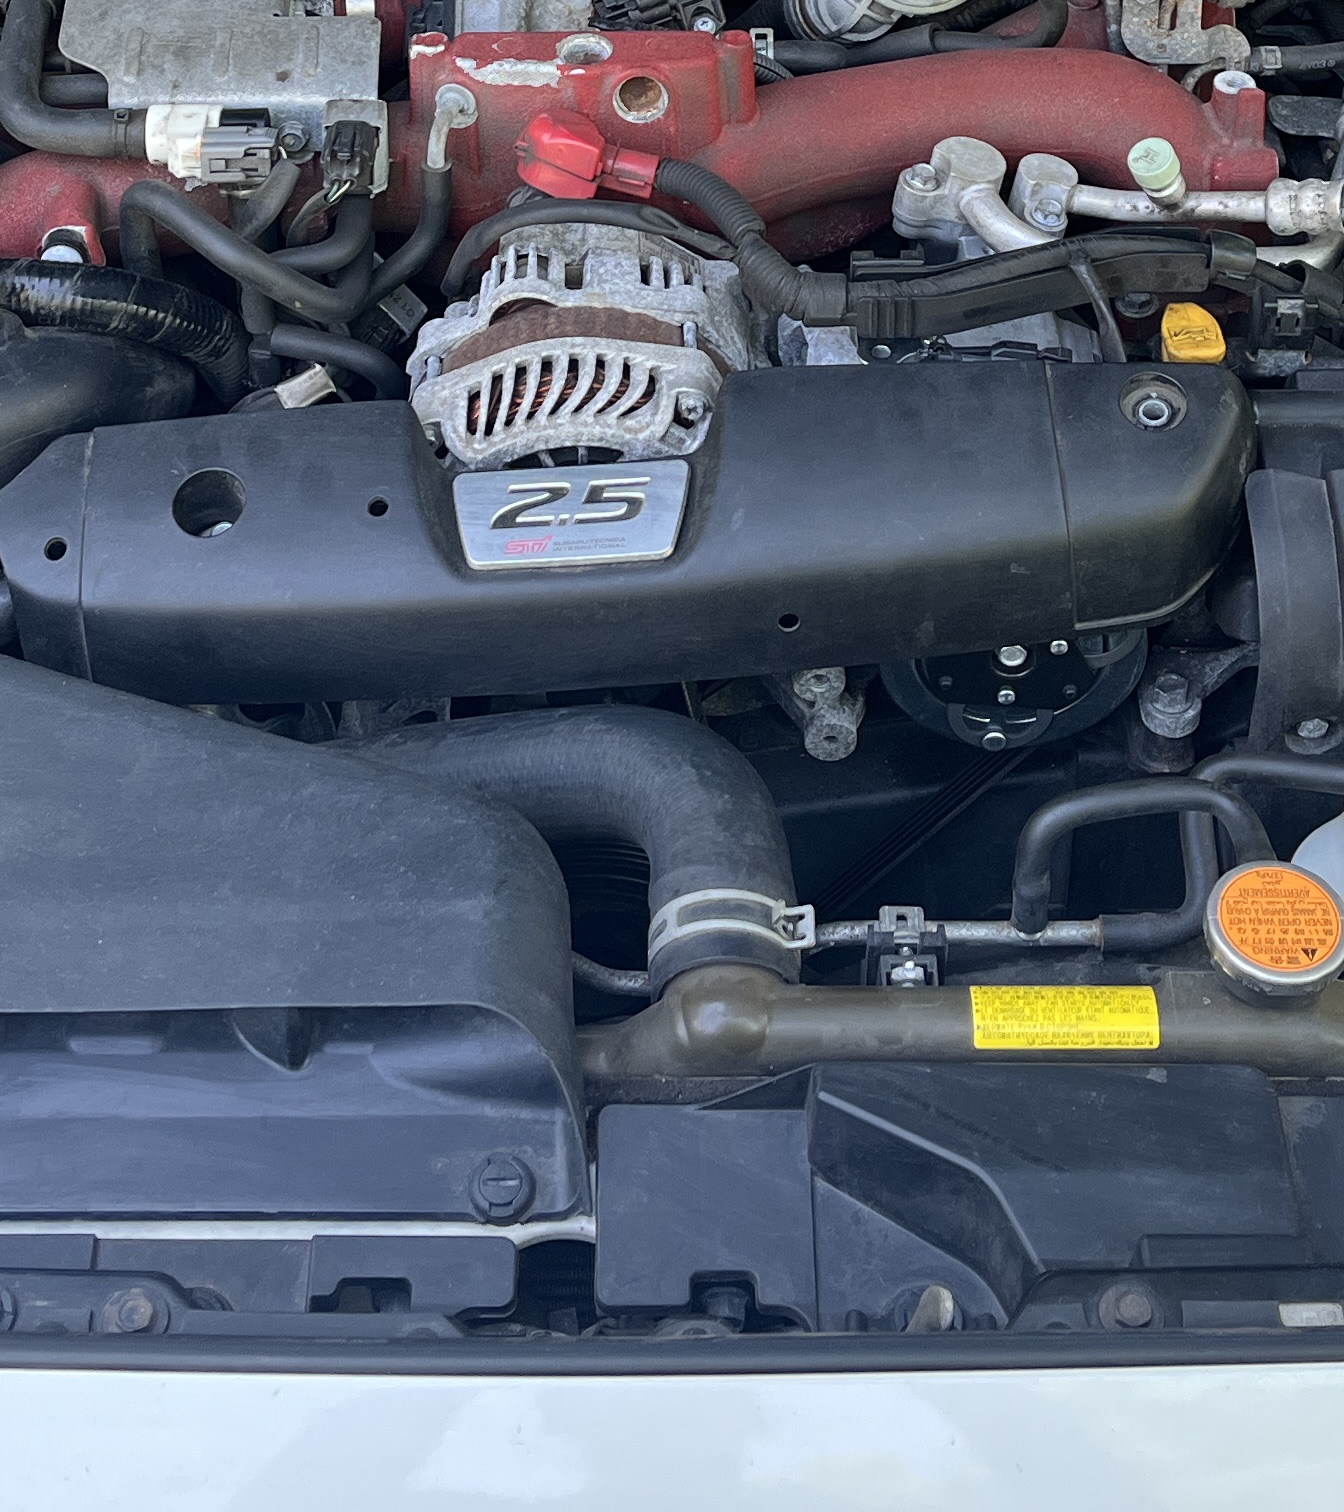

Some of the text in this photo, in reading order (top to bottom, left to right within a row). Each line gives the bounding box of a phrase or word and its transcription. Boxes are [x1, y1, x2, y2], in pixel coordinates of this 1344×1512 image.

[490, 476, 651, 529] 2.5
[1238, 888, 1311, 897] AVERTISSEMENT
[1228, 918, 1333, 927] NEVER OPEN WHEN HOT
[1253, 946, 1301, 955] WARNING
